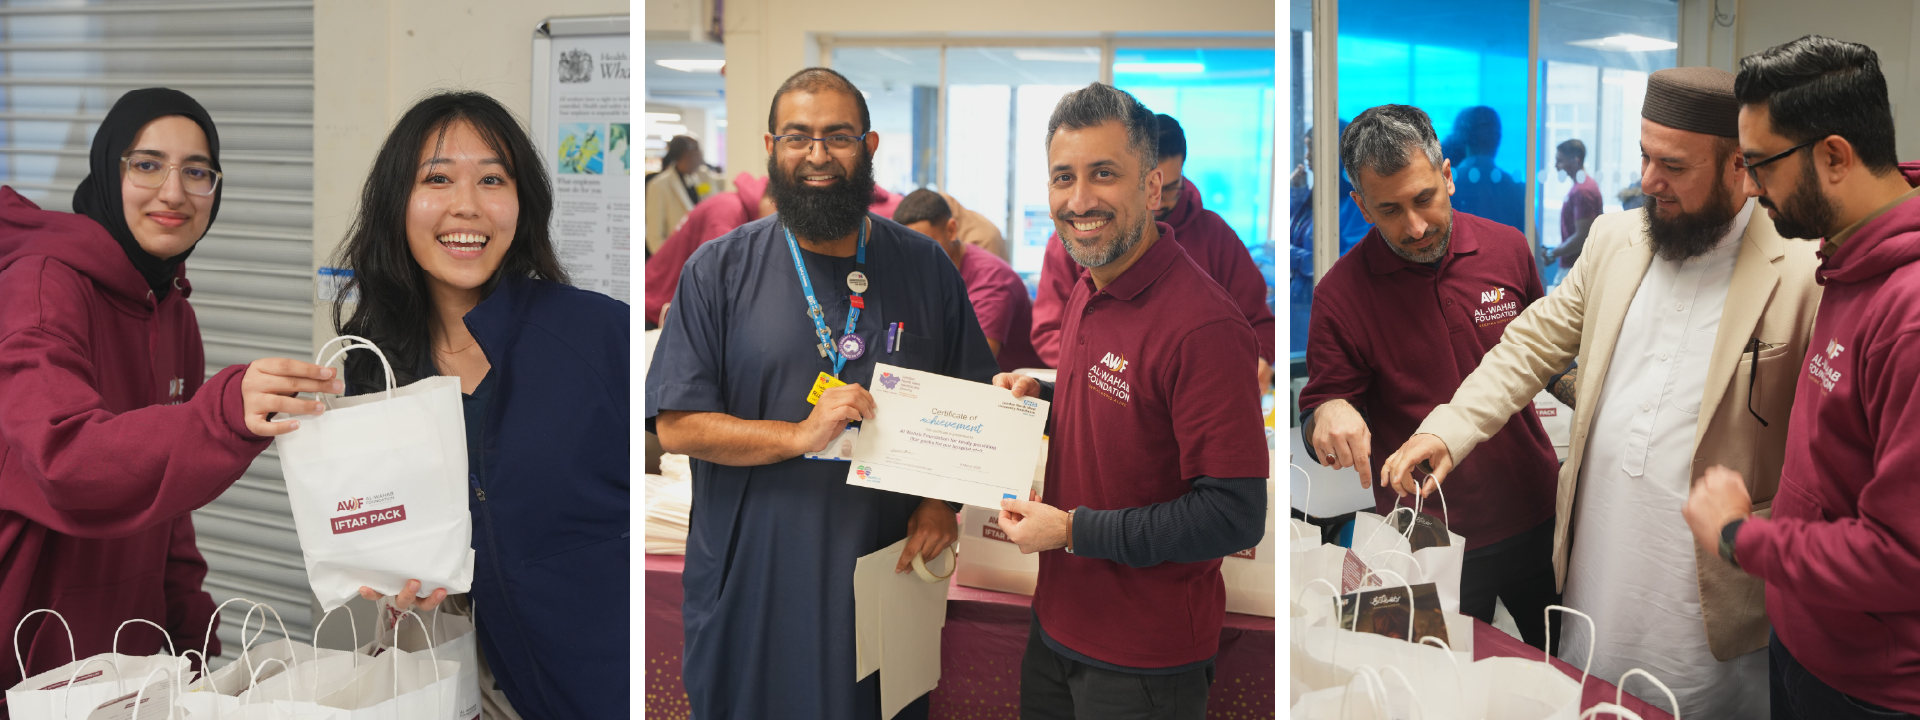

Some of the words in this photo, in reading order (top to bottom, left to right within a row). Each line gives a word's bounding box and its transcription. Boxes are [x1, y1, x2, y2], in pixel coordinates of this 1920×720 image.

[1481, 286, 1505, 304] AWF
[1474, 301, 1517, 317] AL-WAHAB
[1475, 310, 1517, 324] FOUNDATION
[1100, 351, 1129, 373] AWF
[1088, 372, 1130, 402] FOUNDATION
[931, 407, 968, 421] Certificate
[919, 415, 984, 434] achievement
[923, 432, 950, 442] Foundation
[958, 439, 973, 448] kindly
[973, 442, 997, 451] providing
[336, 496, 364, 512] AWF
[365, 491, 395, 501] AL-WAHAB
[365, 495, 395, 505] FOUNDATION
[334, 516, 368, 531] IFTAR
[370, 509, 402, 524] PACK
[985, 528, 1006, 540] IFTAR
